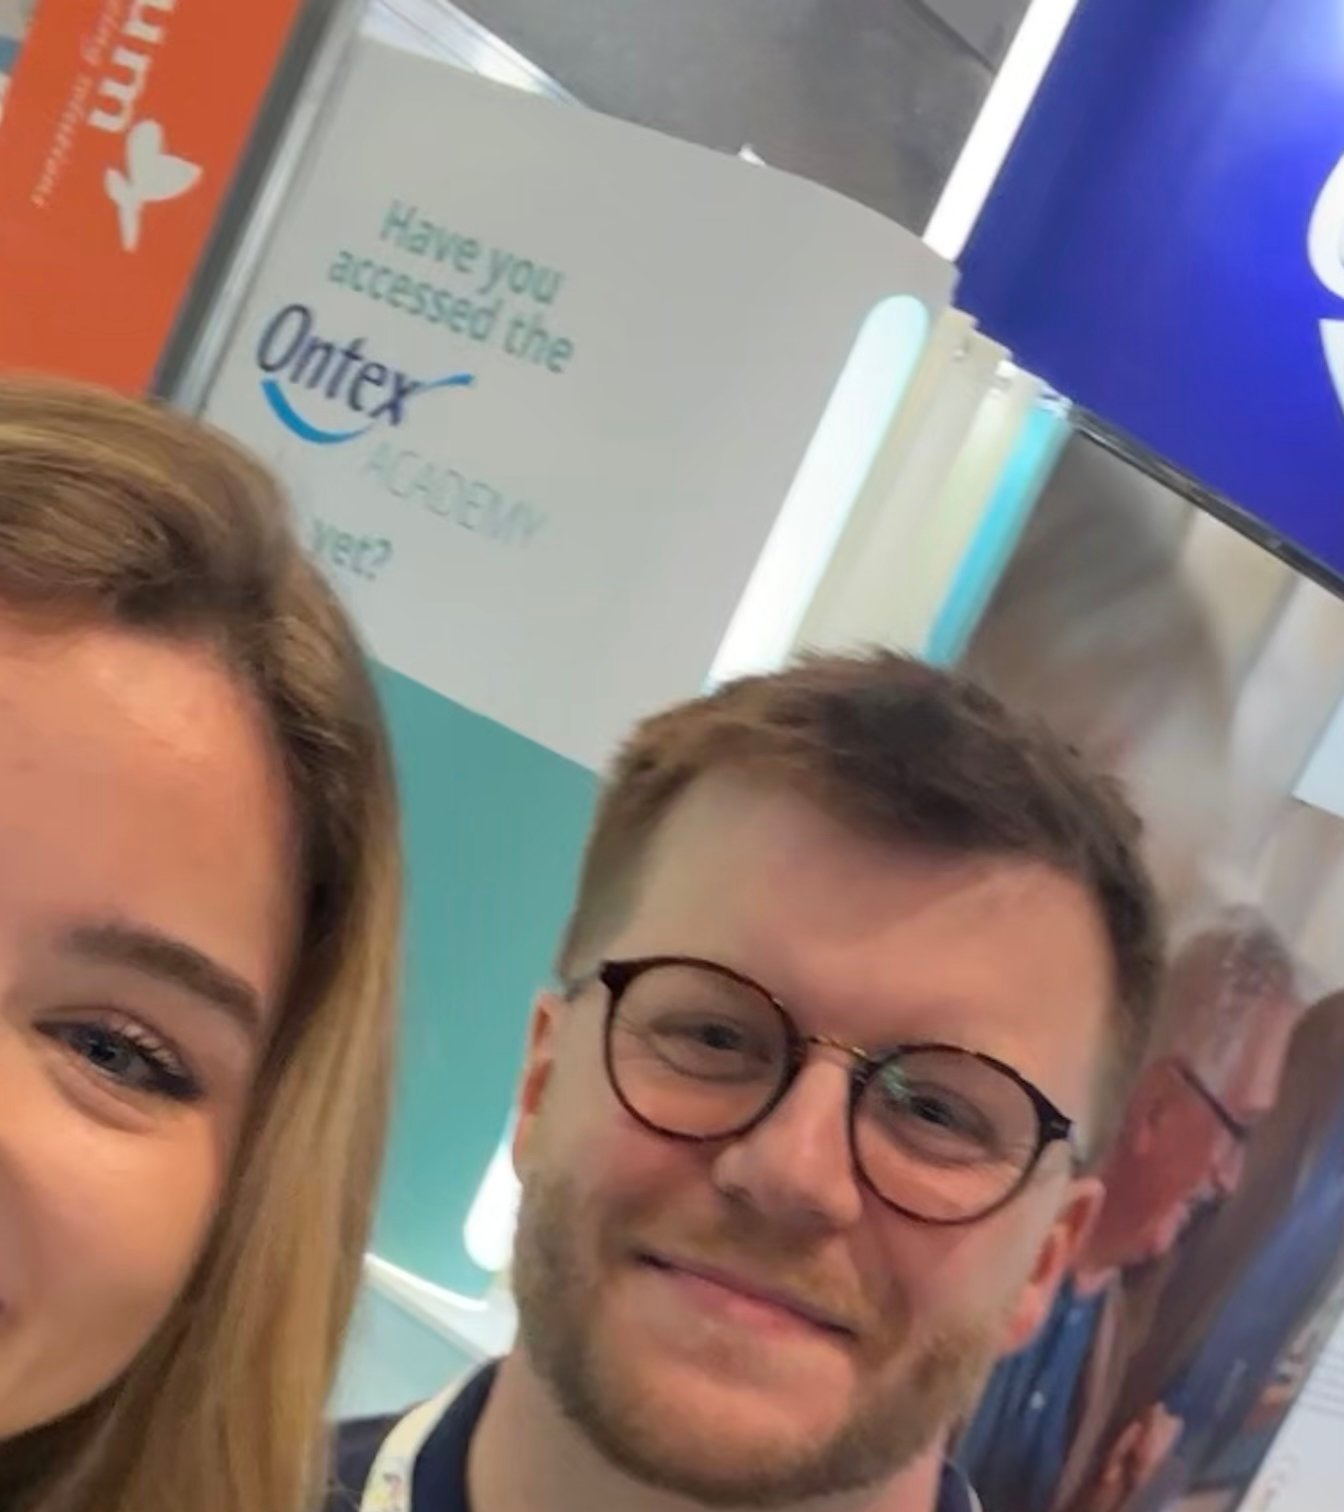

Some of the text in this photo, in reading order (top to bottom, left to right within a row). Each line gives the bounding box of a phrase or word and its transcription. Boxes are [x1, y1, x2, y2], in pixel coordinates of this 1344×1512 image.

[380, 200, 564, 306] Have you
[328, 249, 574, 374] accessed the
[256, 303, 474, 427] Ontex
[362, 442, 549, 547] ACADEMY
[312, 515, 393, 581] yet?
